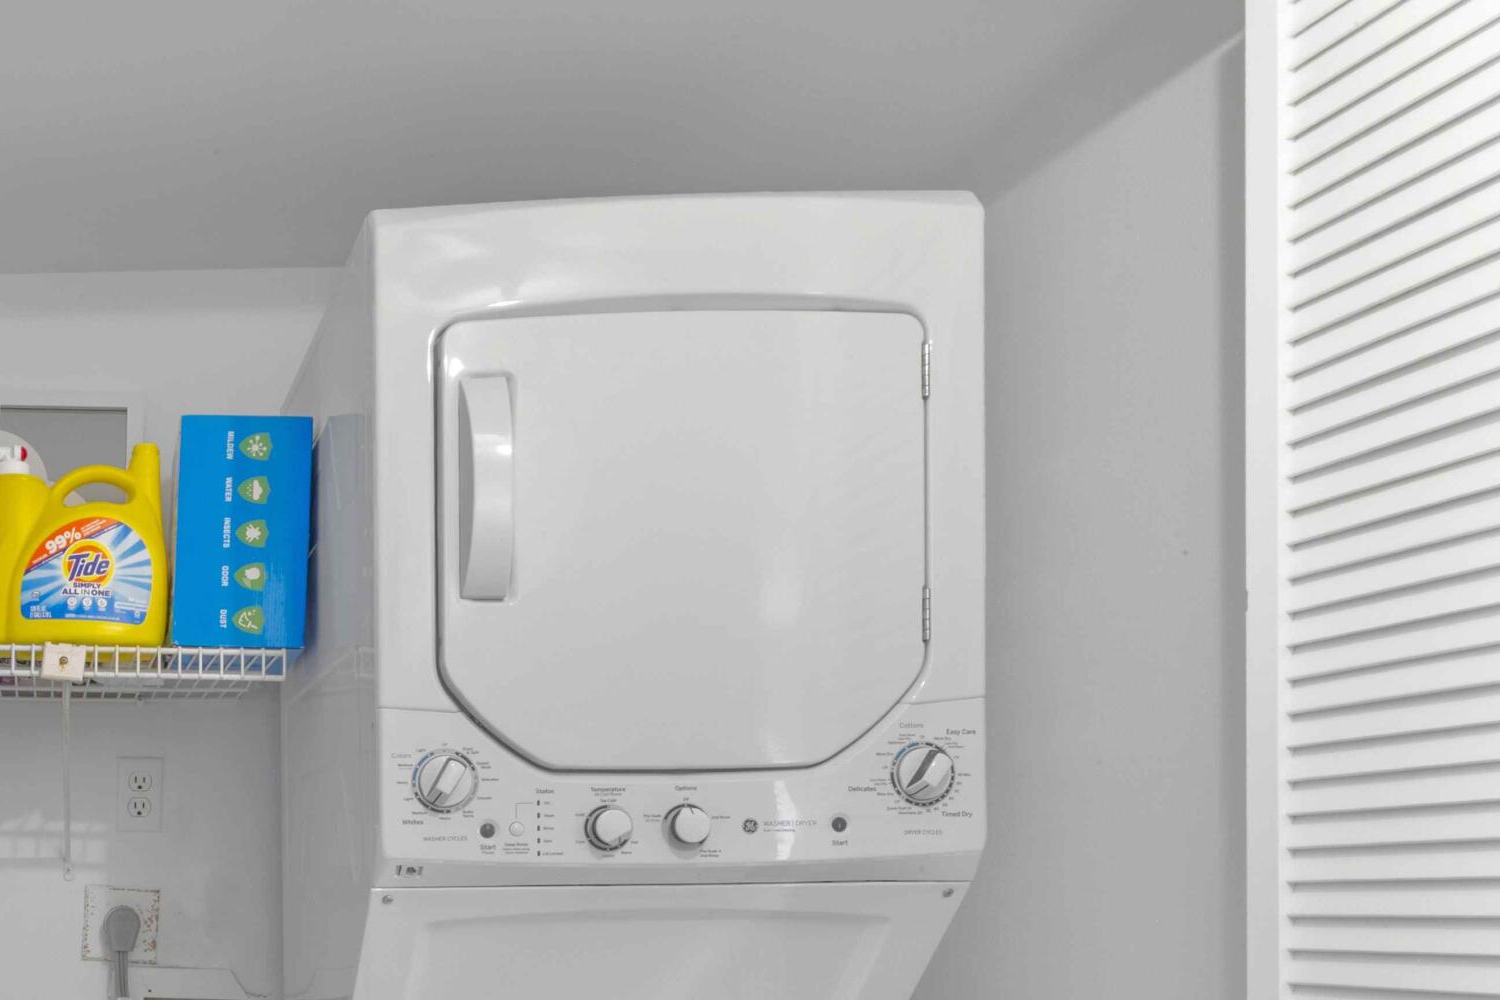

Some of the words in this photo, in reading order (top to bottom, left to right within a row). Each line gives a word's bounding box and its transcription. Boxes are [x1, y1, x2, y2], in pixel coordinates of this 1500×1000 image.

[226, 431, 235, 459] MILDEW
[225, 477, 233, 502] WATER
[45, 528, 82, 554] 99%
[223, 517, 231, 548] INSECTS
[68, 552, 110, 582] Tide
[221, 565, 229, 587] ODOR
